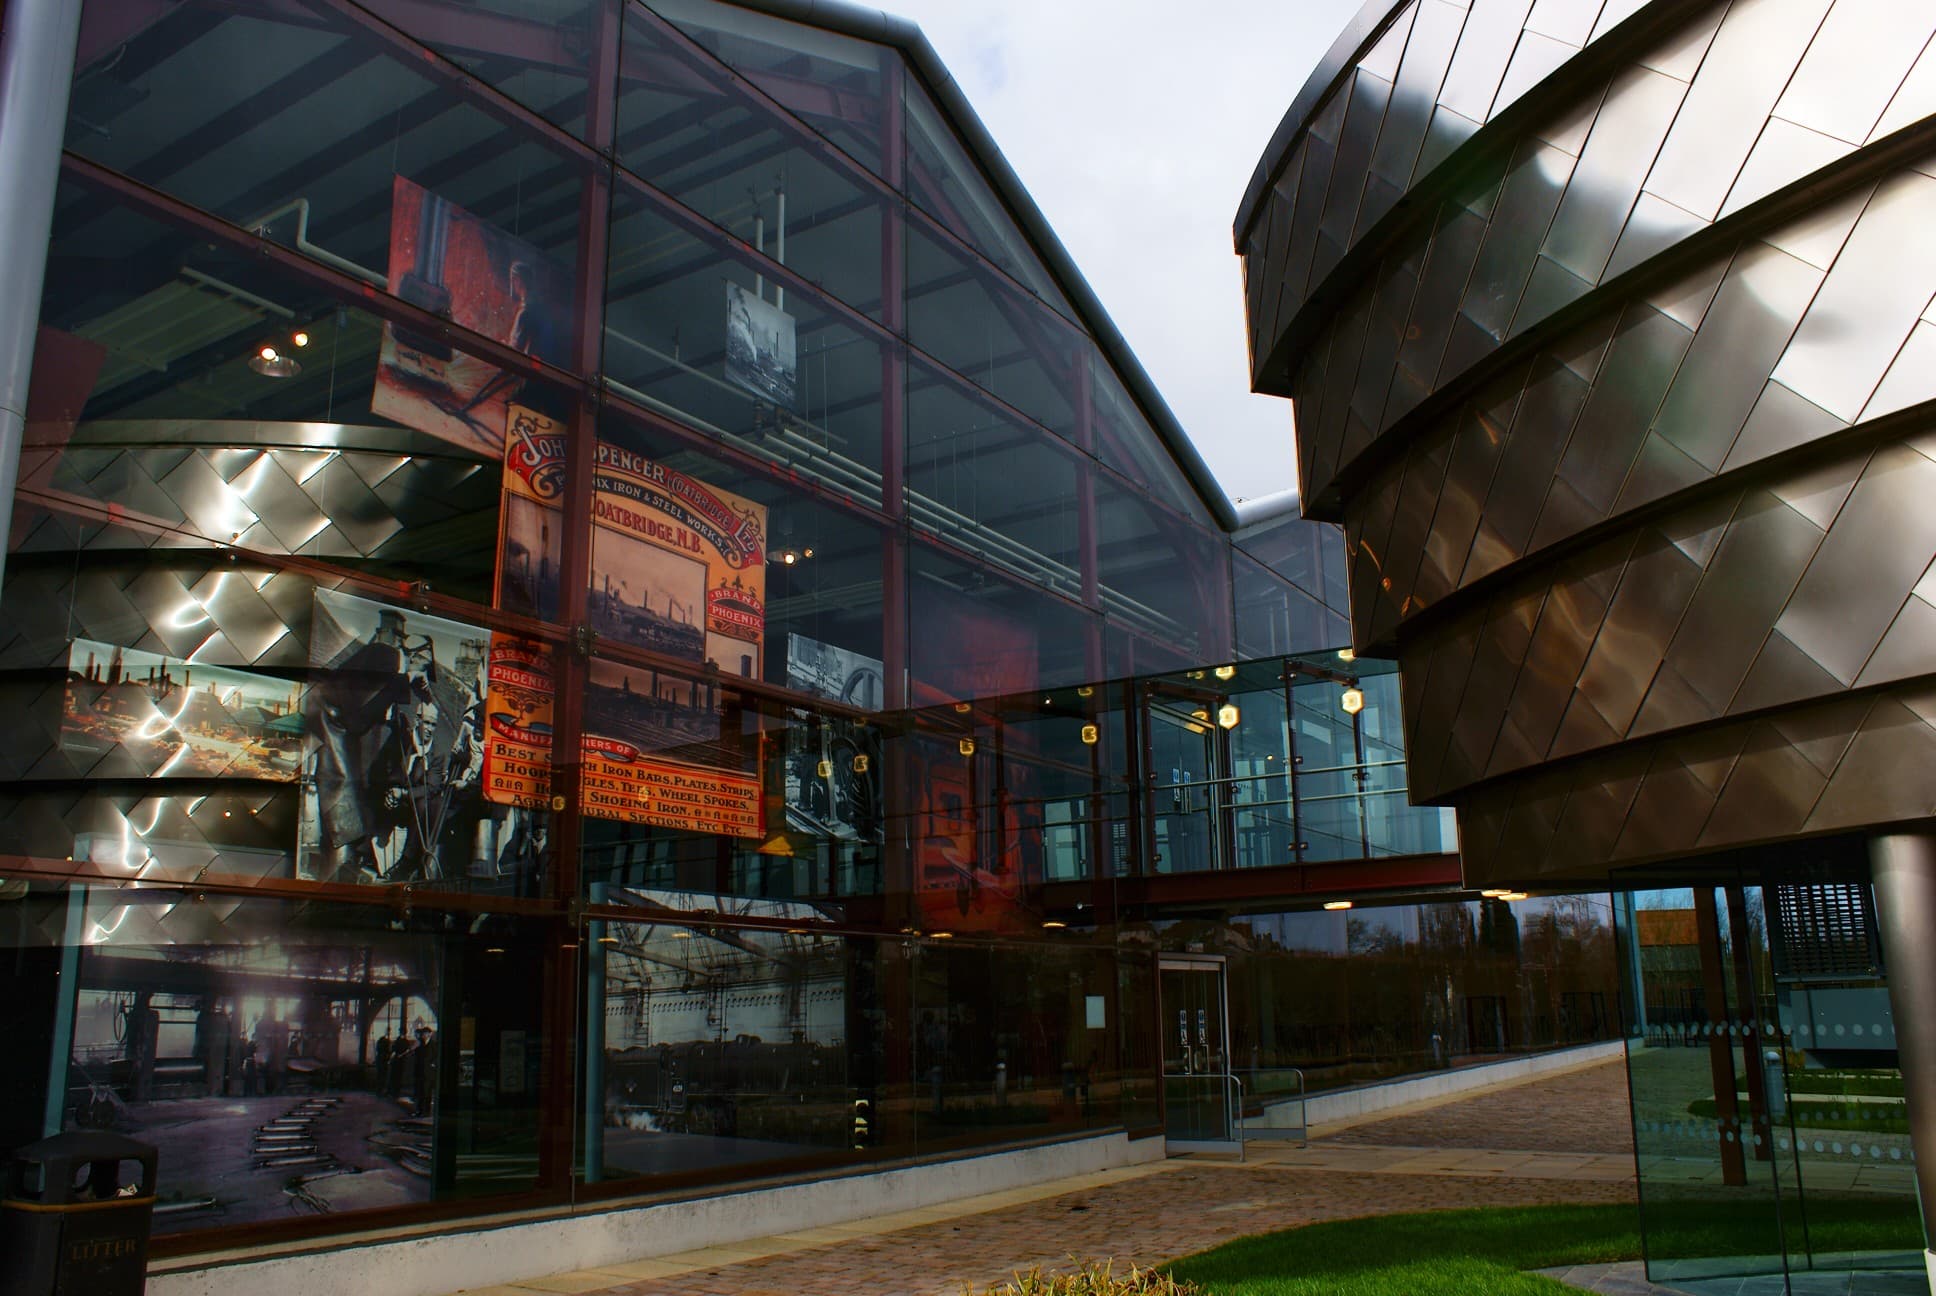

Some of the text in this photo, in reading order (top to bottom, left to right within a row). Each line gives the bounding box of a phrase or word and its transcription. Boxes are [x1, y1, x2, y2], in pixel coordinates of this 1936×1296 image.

[519, 425, 567, 466] JOH
[613, 482, 641, 498] IRON
[652, 495, 683, 519] STEEL
[715, 590, 760, 610] BRAND
[712, 605, 761, 627] PHOENIX
[494, 649, 550, 668] BRAND
[492, 667, 550, 689] PHOENIX
[616, 744, 630, 753] OF
[496, 744, 536, 760] BEST
[603, 764, 632, 778] IRON
[590, 792, 650, 809] SHOEING
[659, 788, 700, 803] WHEEL
